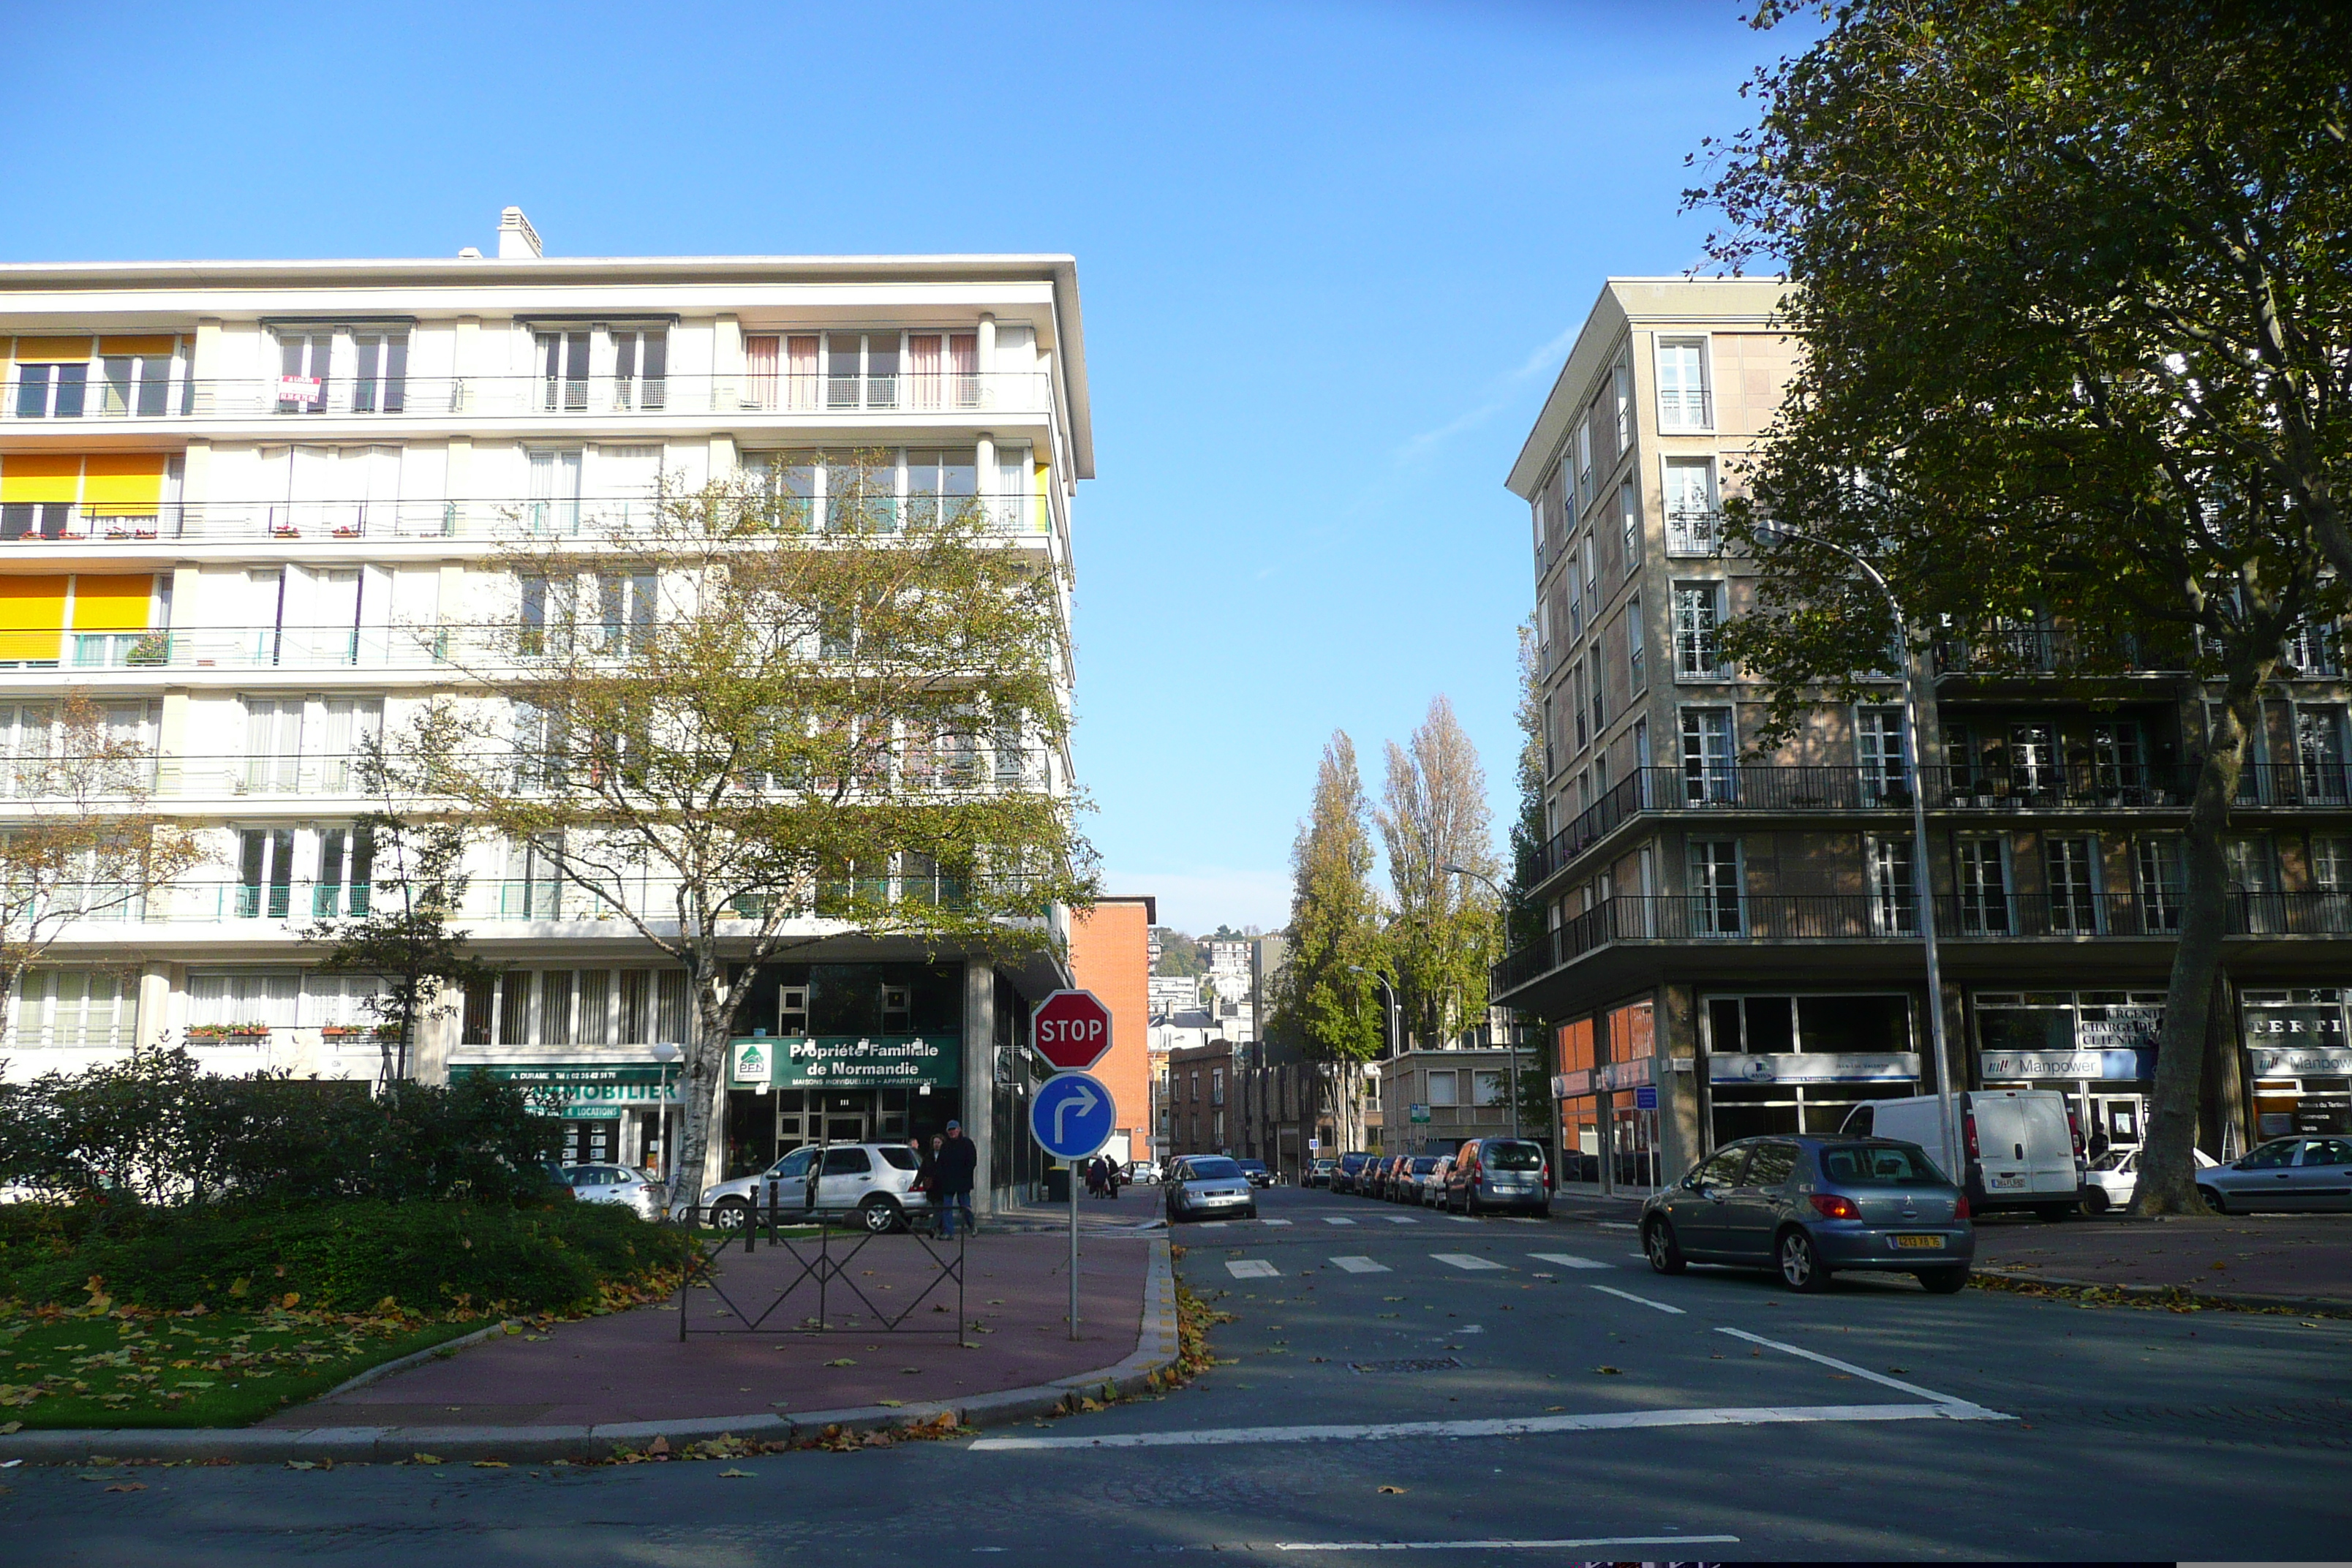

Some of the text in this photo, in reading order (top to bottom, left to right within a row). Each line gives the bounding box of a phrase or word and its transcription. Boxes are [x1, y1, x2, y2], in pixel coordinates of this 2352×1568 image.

[2107, 1009, 2160, 1019] URGENT
[1041, 1019, 1102, 1041] STOP
[870, 1043, 938, 1056] Familiale
[807, 1061, 919, 1076] de Normandie
[2019, 1059, 2095, 1074] Manpower
[2290, 1057, 2352, 1071] Manpow
[577, 1107, 617, 1116] LOCATIONS
